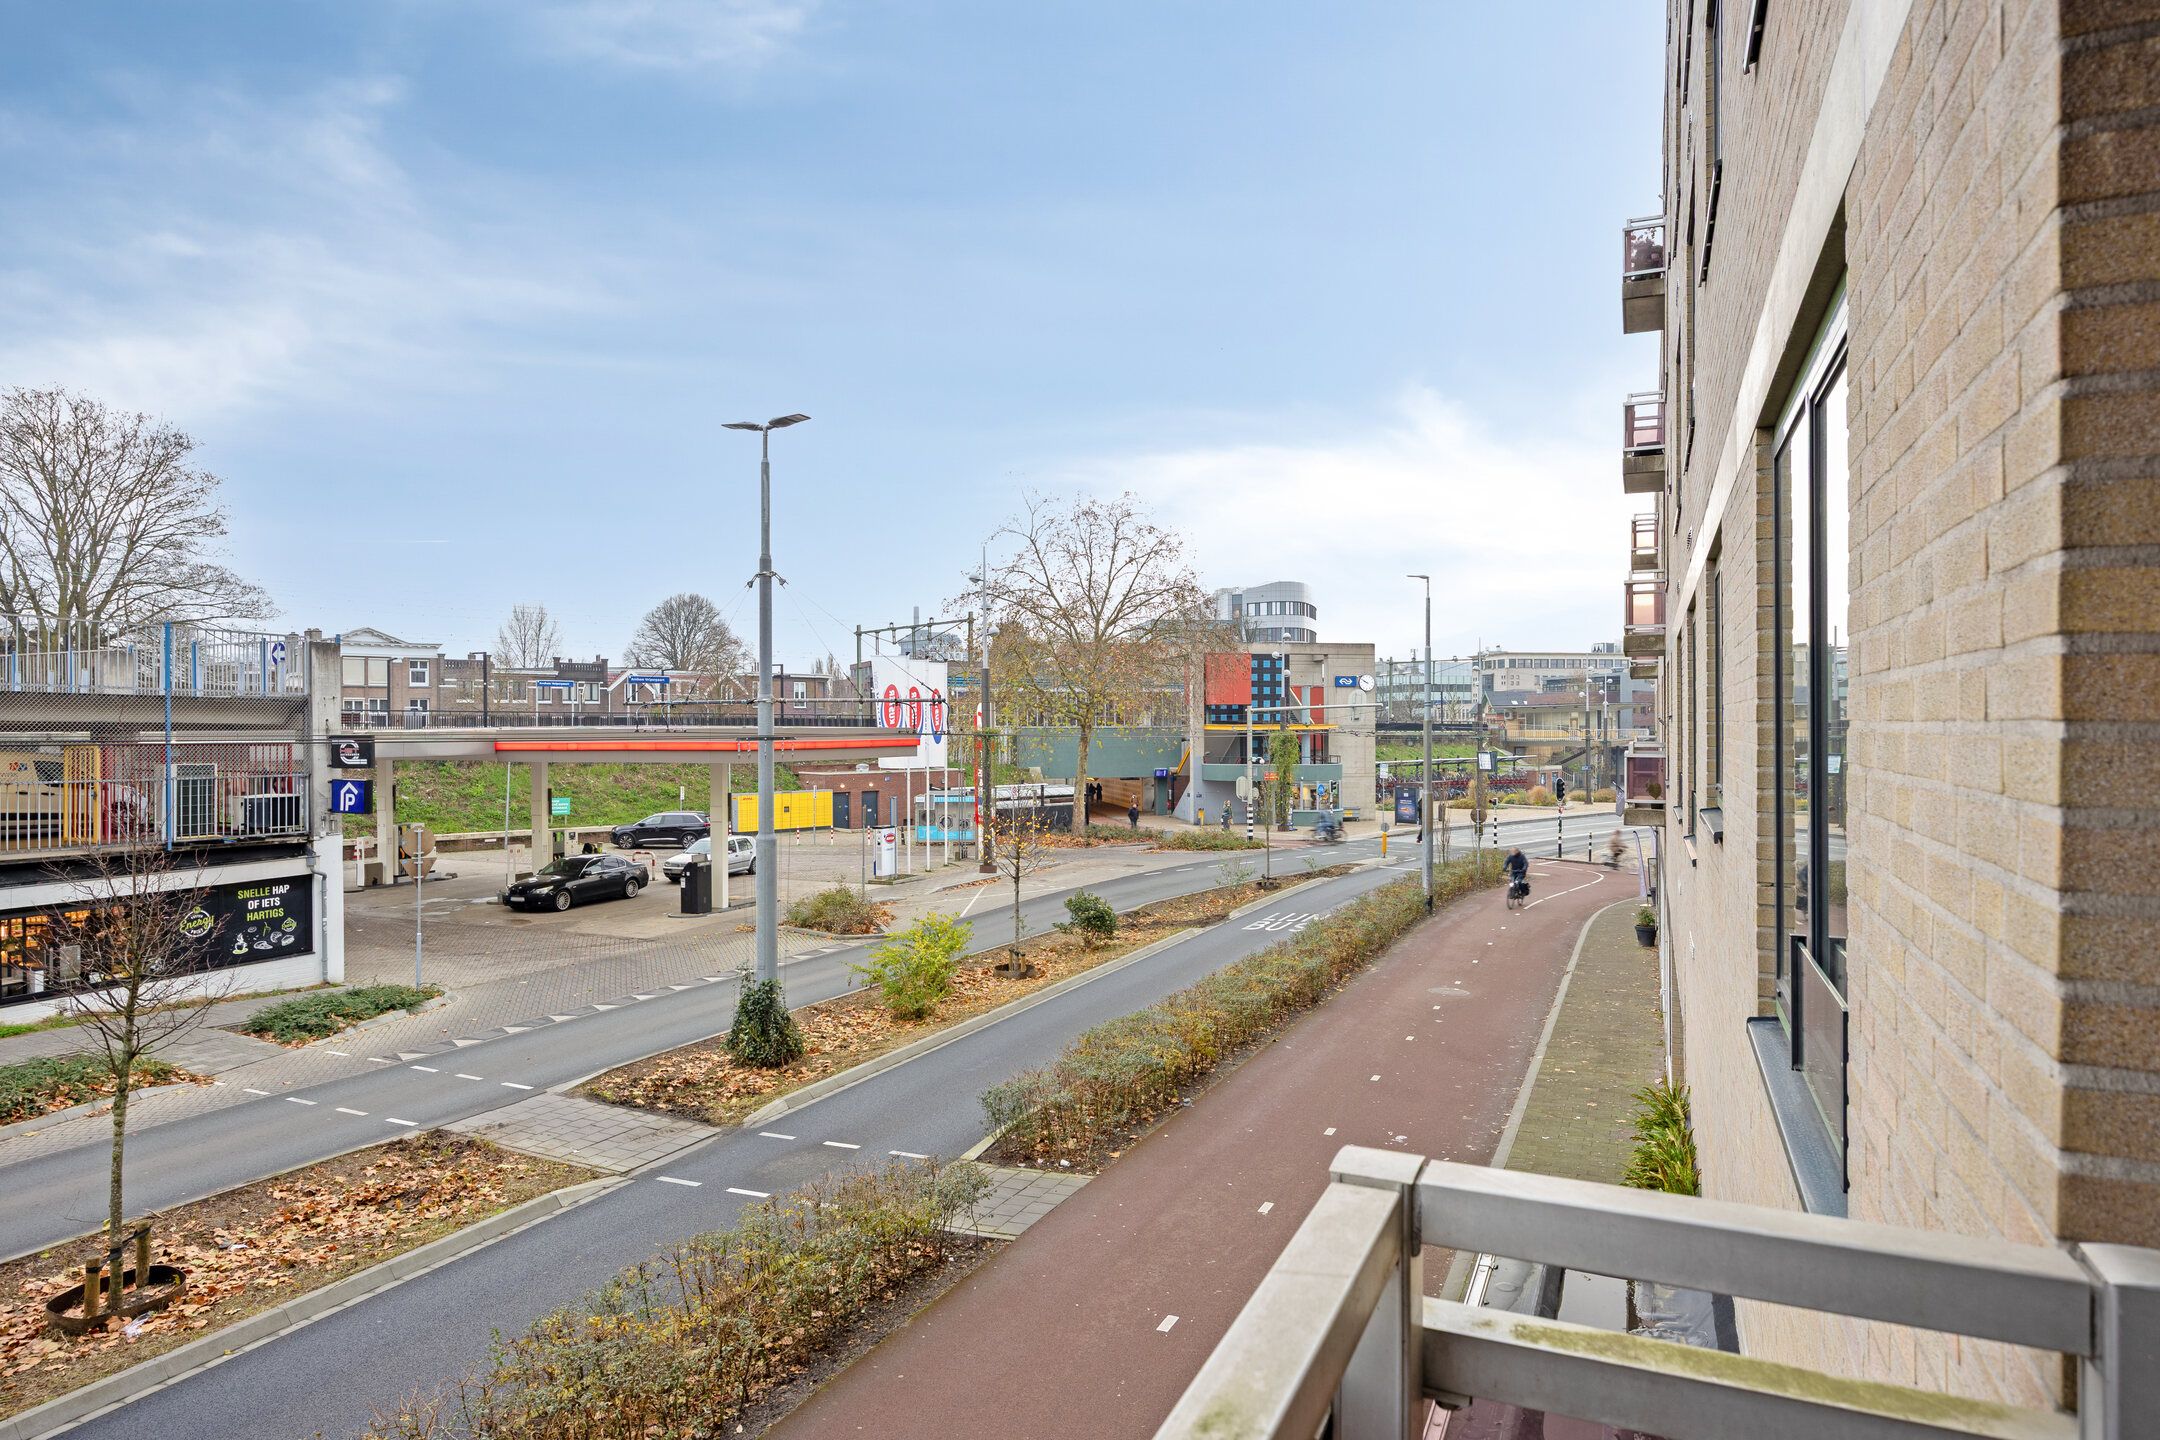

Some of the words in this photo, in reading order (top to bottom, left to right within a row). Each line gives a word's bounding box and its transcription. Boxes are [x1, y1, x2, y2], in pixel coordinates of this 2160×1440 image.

[345, 793, 356, 811] P
[237, 886, 270, 899] SNELLE
[272, 884, 290, 895] HAP
[247, 899, 260, 910] OF
[261, 897, 281, 908] IETS
[246, 908, 284, 921] HARTIGS
[179, 915, 214, 933] Energy
[1241, 920, 1308, 932] BUS
